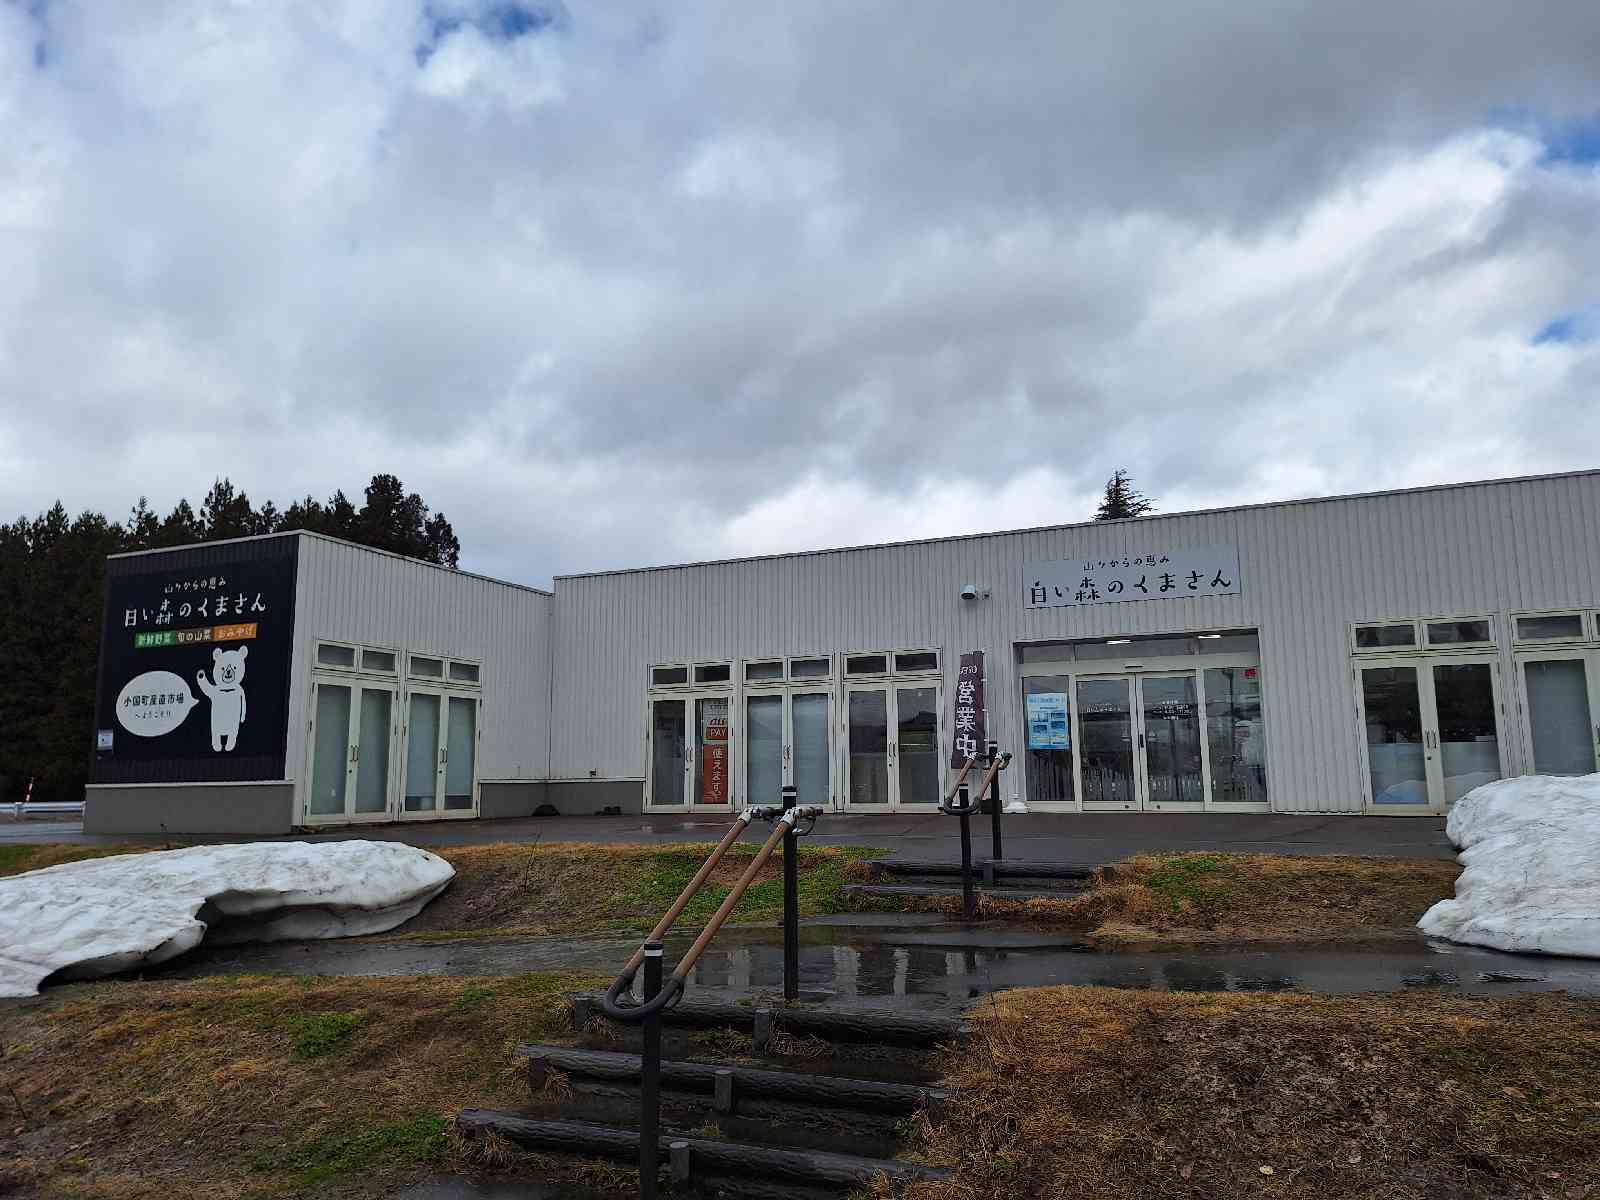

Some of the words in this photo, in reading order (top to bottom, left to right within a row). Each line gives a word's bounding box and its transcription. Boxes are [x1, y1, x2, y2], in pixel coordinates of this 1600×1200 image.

[1083, 554, 1170, 571] 山々からの恵み
[1031, 569, 1231, 604] 白い森のくまさん
[956, 680, 977, 758] 営業中
